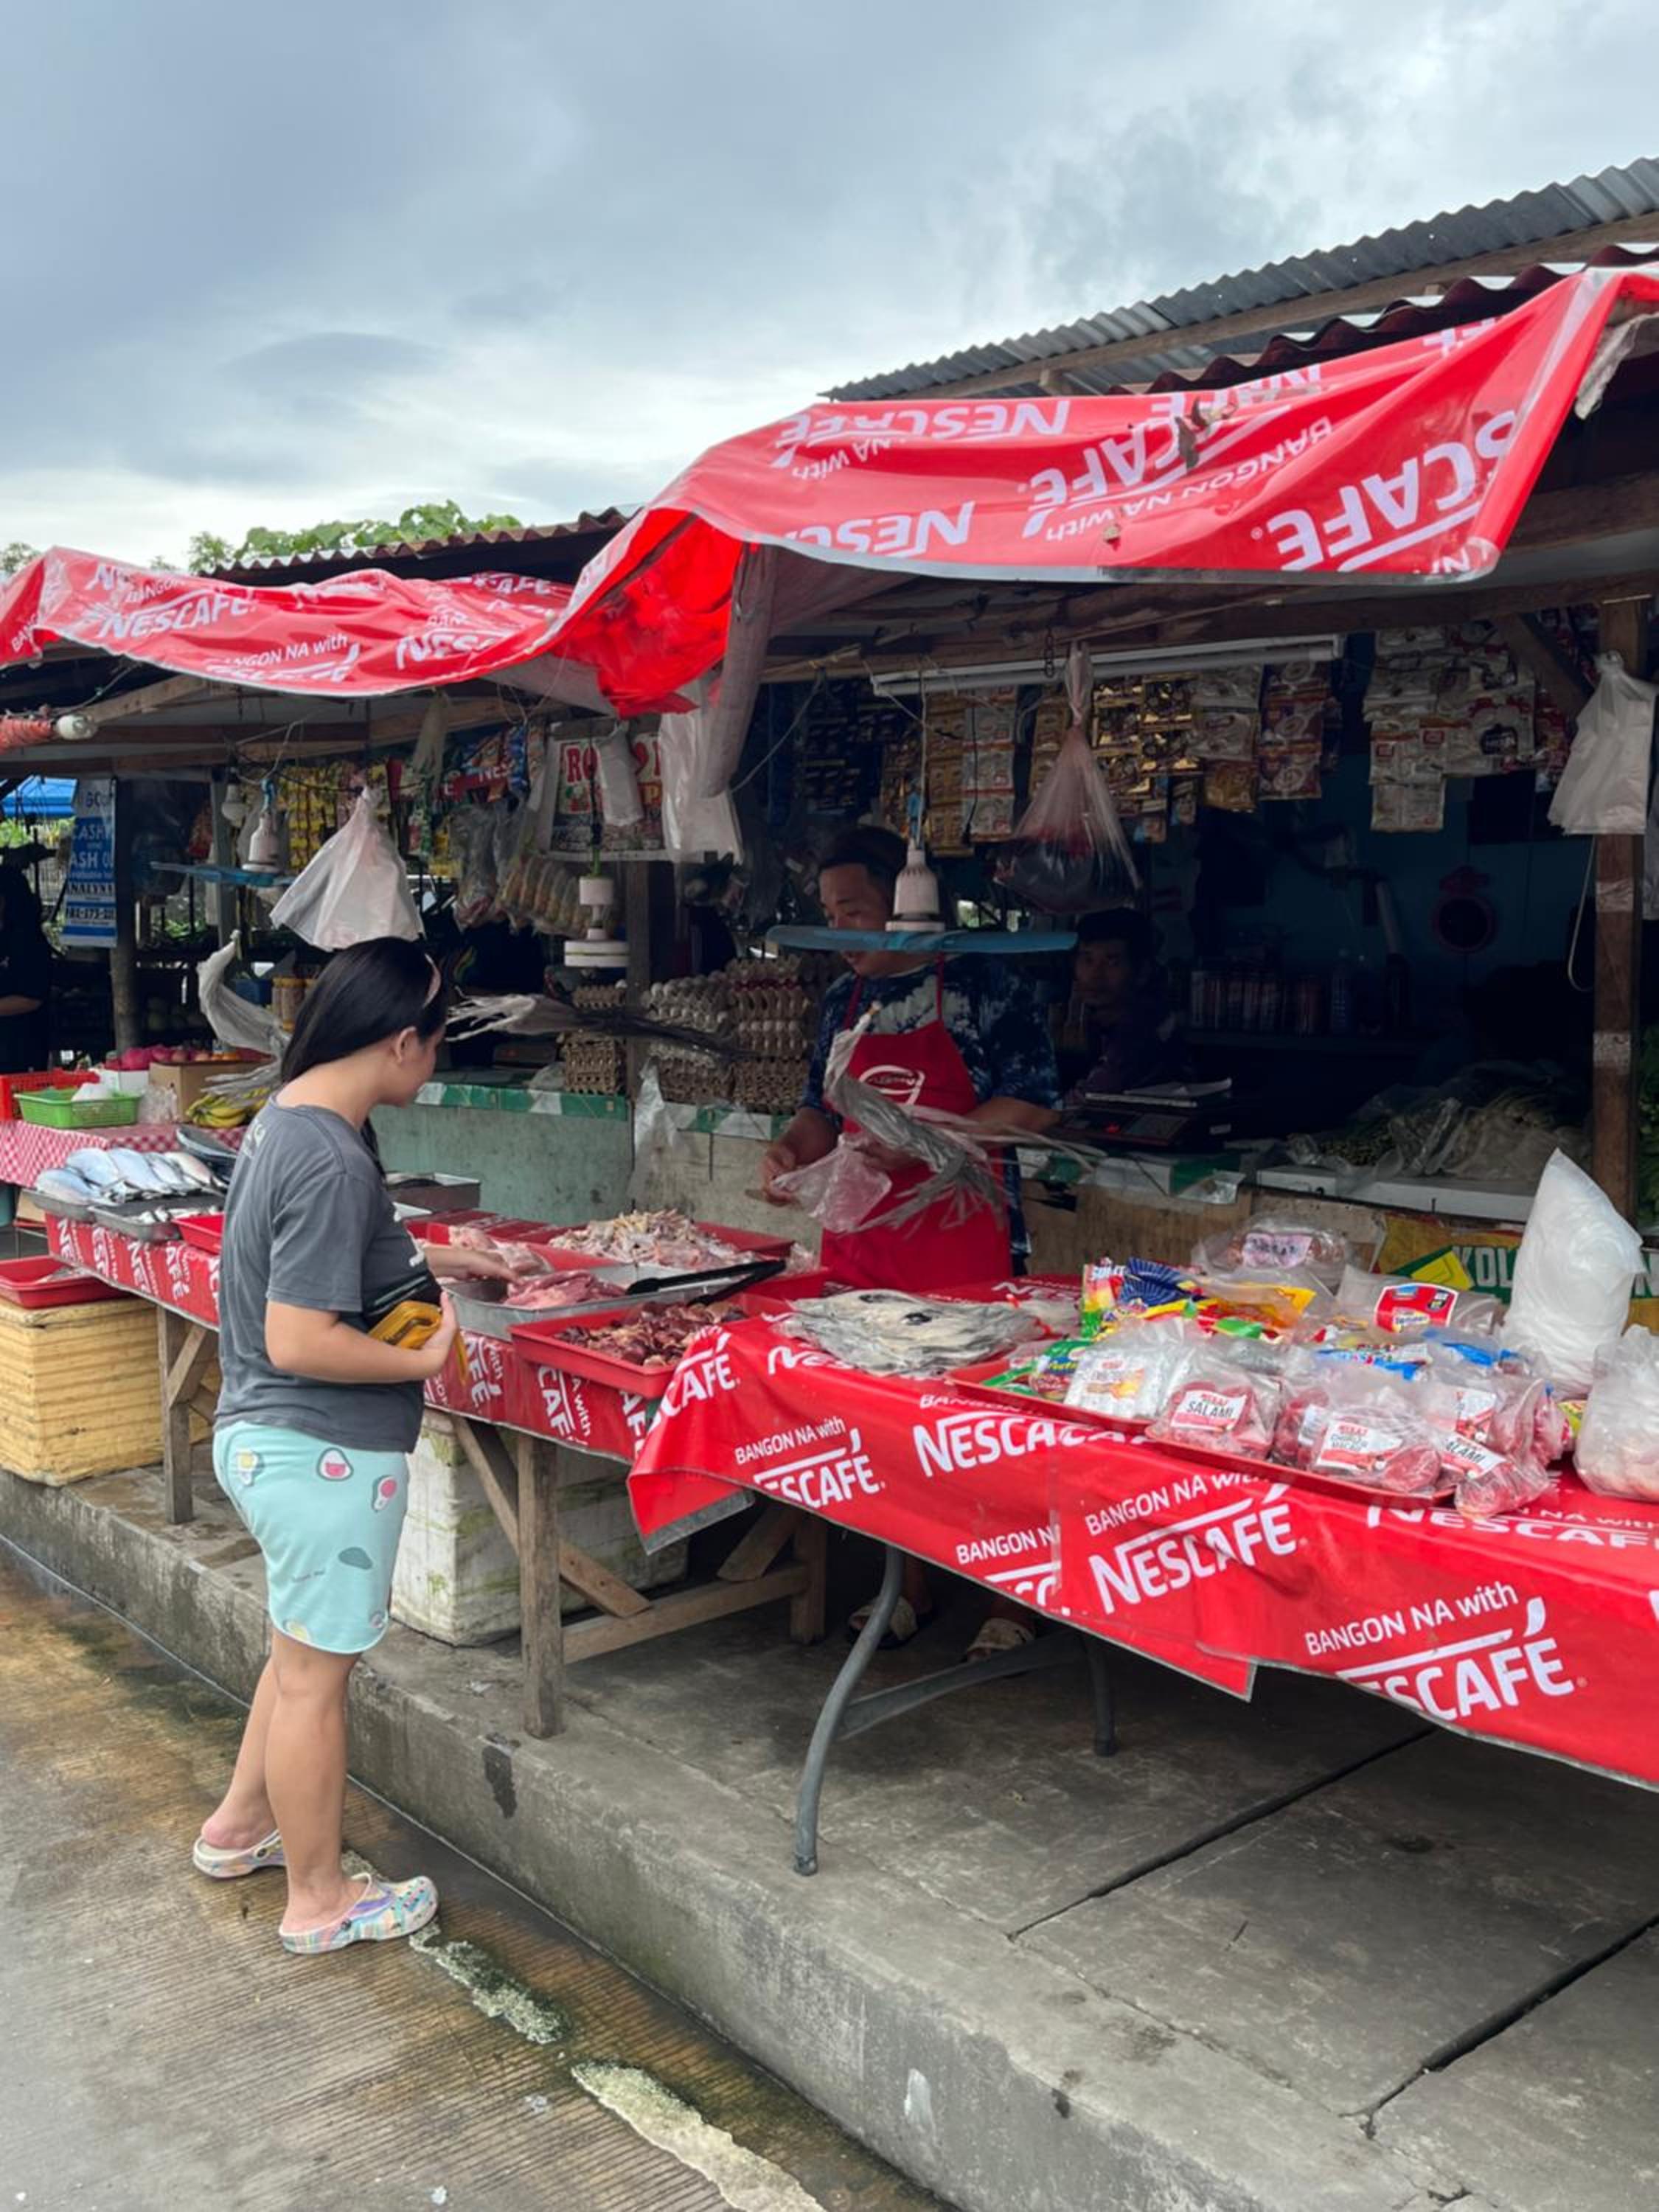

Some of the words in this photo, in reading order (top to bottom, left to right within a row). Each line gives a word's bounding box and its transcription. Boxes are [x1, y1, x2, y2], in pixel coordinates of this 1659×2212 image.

[1181, 416, 1333, 500] BANGON
[1046, 507, 1113, 541] with
[313, 632, 348, 655] with
[574, 1394, 591, 1436] with
[1186, 1401, 1234, 1418] SALAMI
[734, 1432, 796, 1466] BANGON
[796, 1424, 818, 1446] NA
[816, 1415, 847, 1439] with
[1084, 1489, 1171, 1537] BANGON
[1174, 1474, 1209, 1504] NA
[1366, 1505, 1659, 1551] NESCAF
[956, 1528, 1037, 1565] BANGON
[1088, 1482, 1298, 1615] NESCAFÉ
[1304, 1610, 1408, 1656] BANGON
[1410, 1601, 1455, 1632] NA
[1456, 1580, 1520, 1618] with
